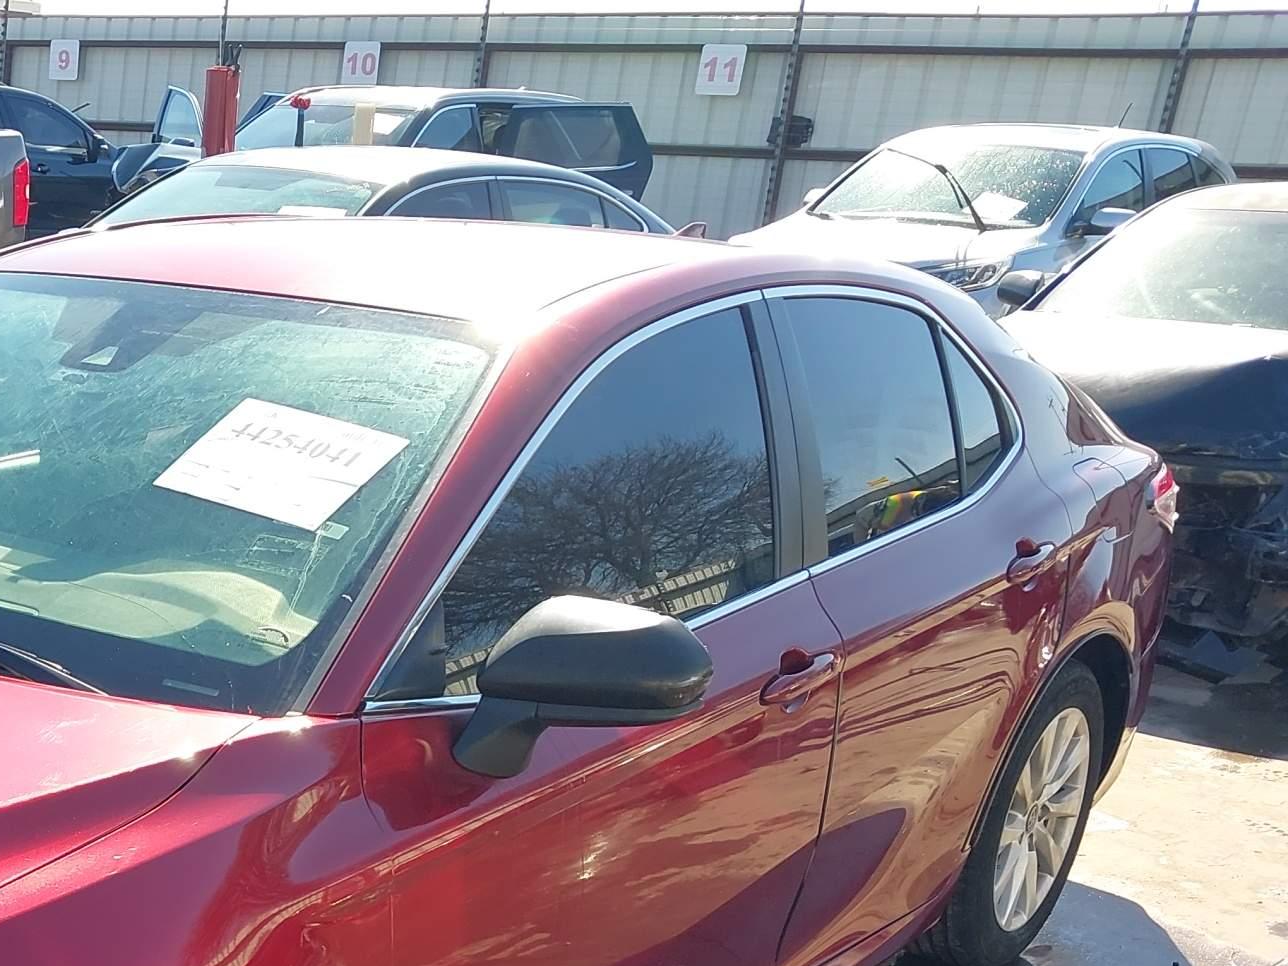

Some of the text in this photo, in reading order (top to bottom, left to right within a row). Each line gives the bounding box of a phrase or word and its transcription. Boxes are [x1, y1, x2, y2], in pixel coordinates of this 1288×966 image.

[57, 50, 71, 71] 9
[345, 51, 377, 76] 10
[703, 56, 739, 83] 11
[231, 422, 361, 467] 44254041
